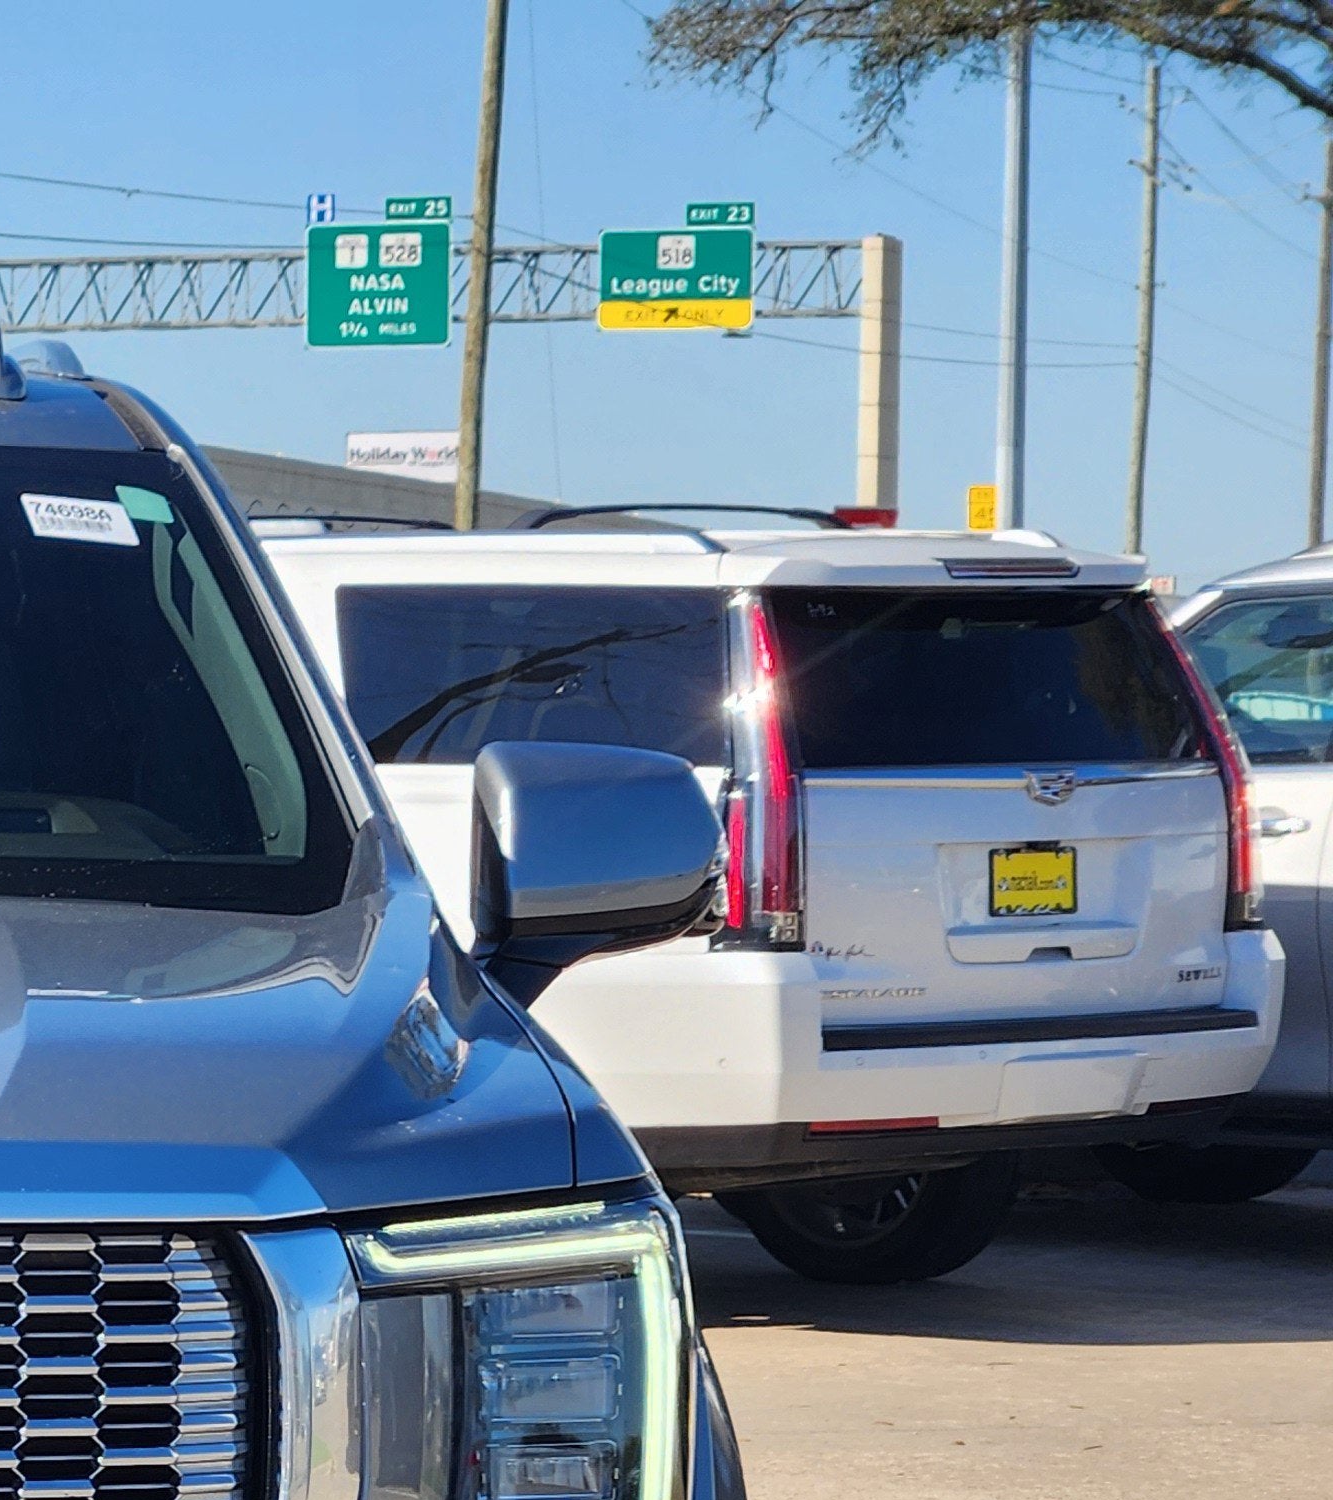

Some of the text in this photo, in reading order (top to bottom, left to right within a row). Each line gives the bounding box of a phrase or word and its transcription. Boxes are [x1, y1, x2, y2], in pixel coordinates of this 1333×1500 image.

[310, 195, 332, 221] H
[389, 200, 448, 216] EXIT 25
[690, 205, 750, 222] EXIT 23
[385, 244, 418, 262] 528
[661, 246, 693, 265] 518
[349, 274, 405, 291] NASA
[610, 274, 740, 297] League City
[348, 297, 409, 315] ALVIN
[624, 307, 724, 322] EXIT ONLY
[379, 322, 417, 335] MILES
[350, 445, 408, 460] Holiday
